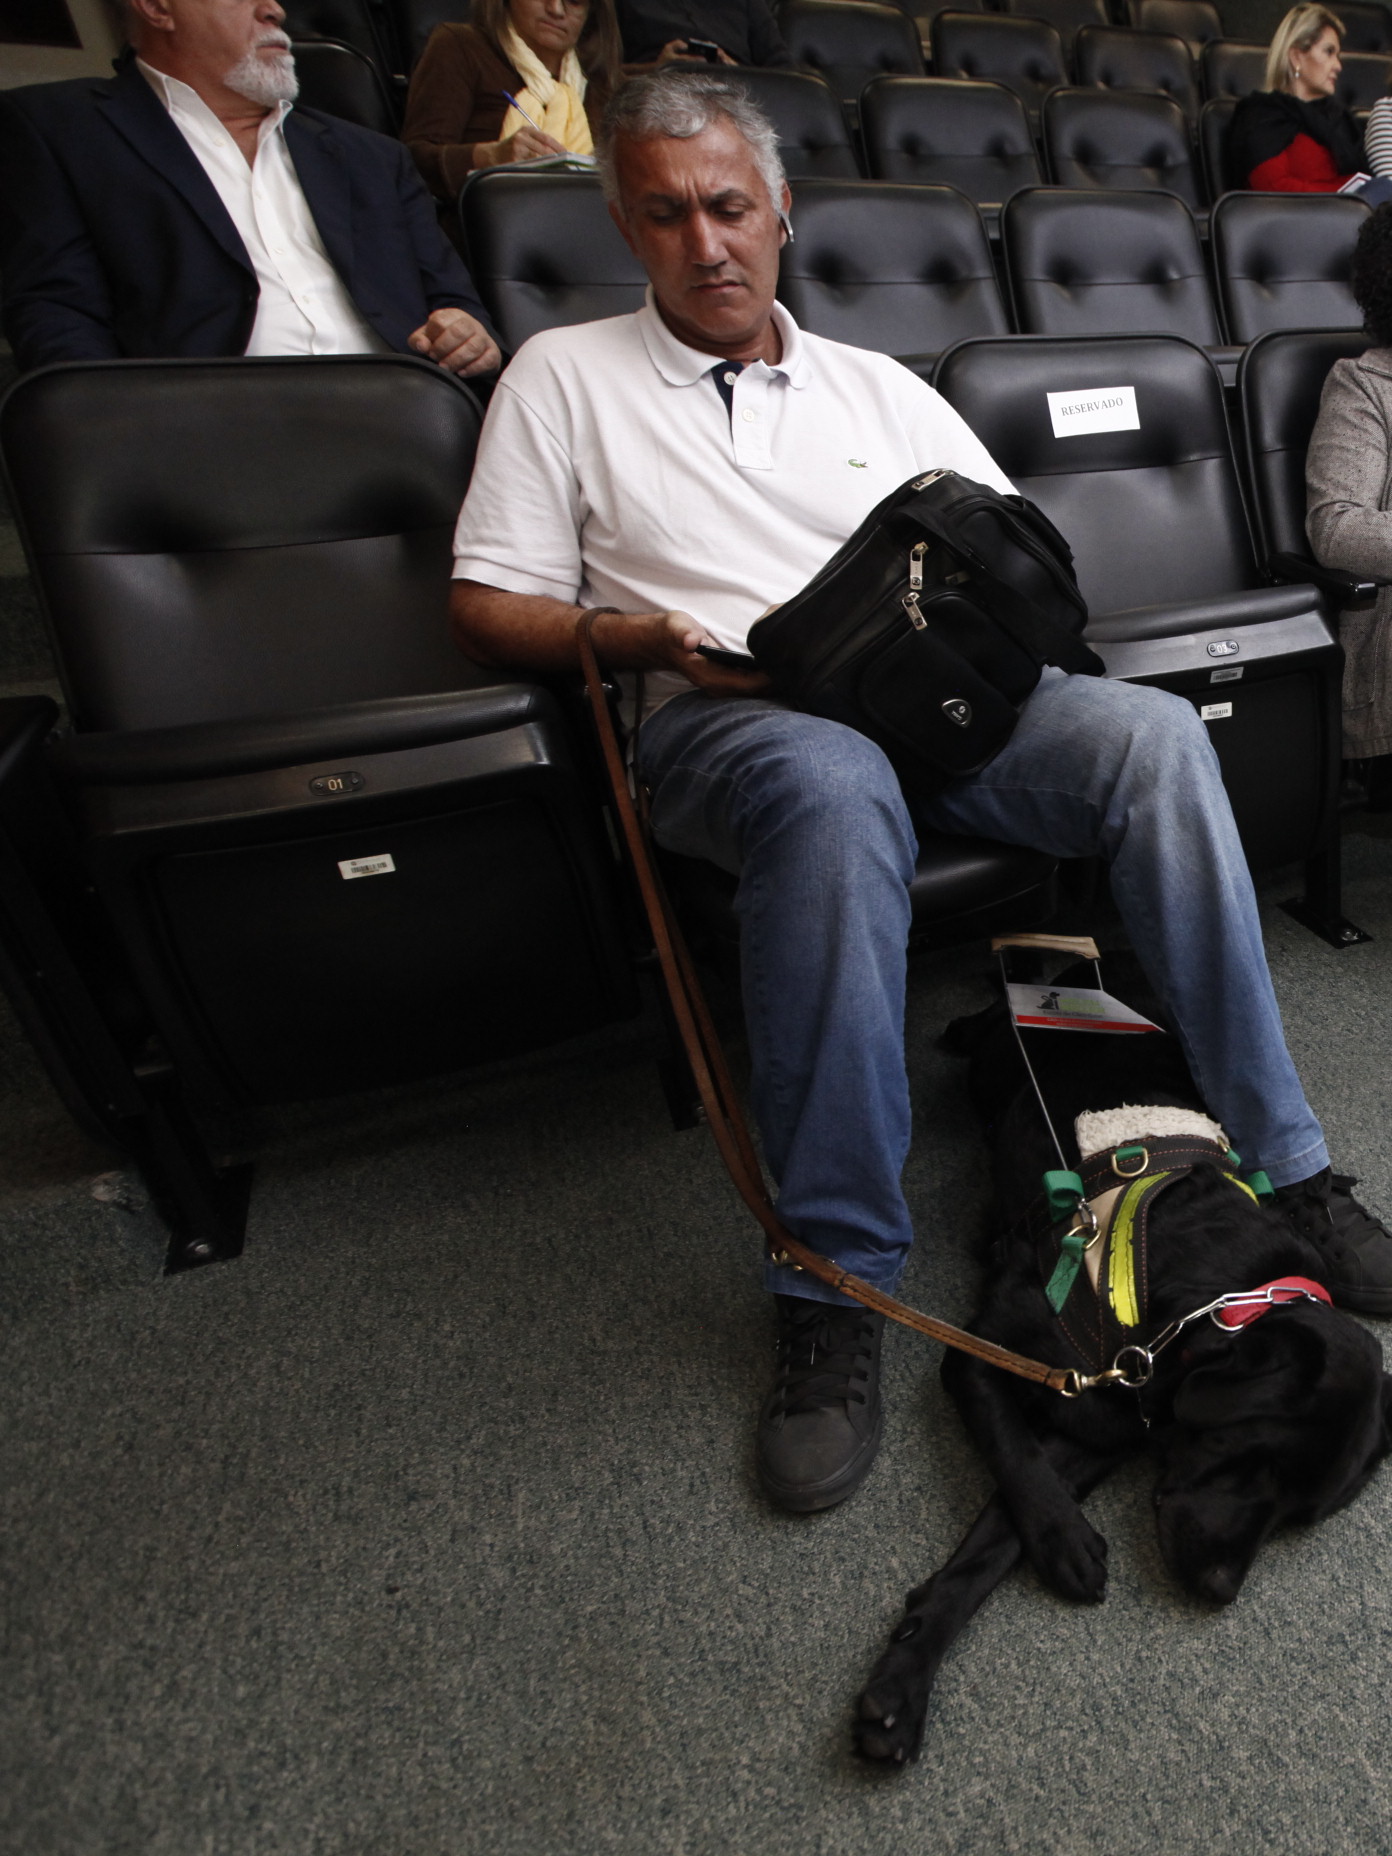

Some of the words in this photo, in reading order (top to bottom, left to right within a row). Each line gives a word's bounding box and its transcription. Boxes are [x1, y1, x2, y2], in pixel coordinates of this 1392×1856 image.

[1061, 396, 1124, 416] RESERVADO
[1216, 643, 1228, 654] 03
[328, 778, 344, 791] 01
